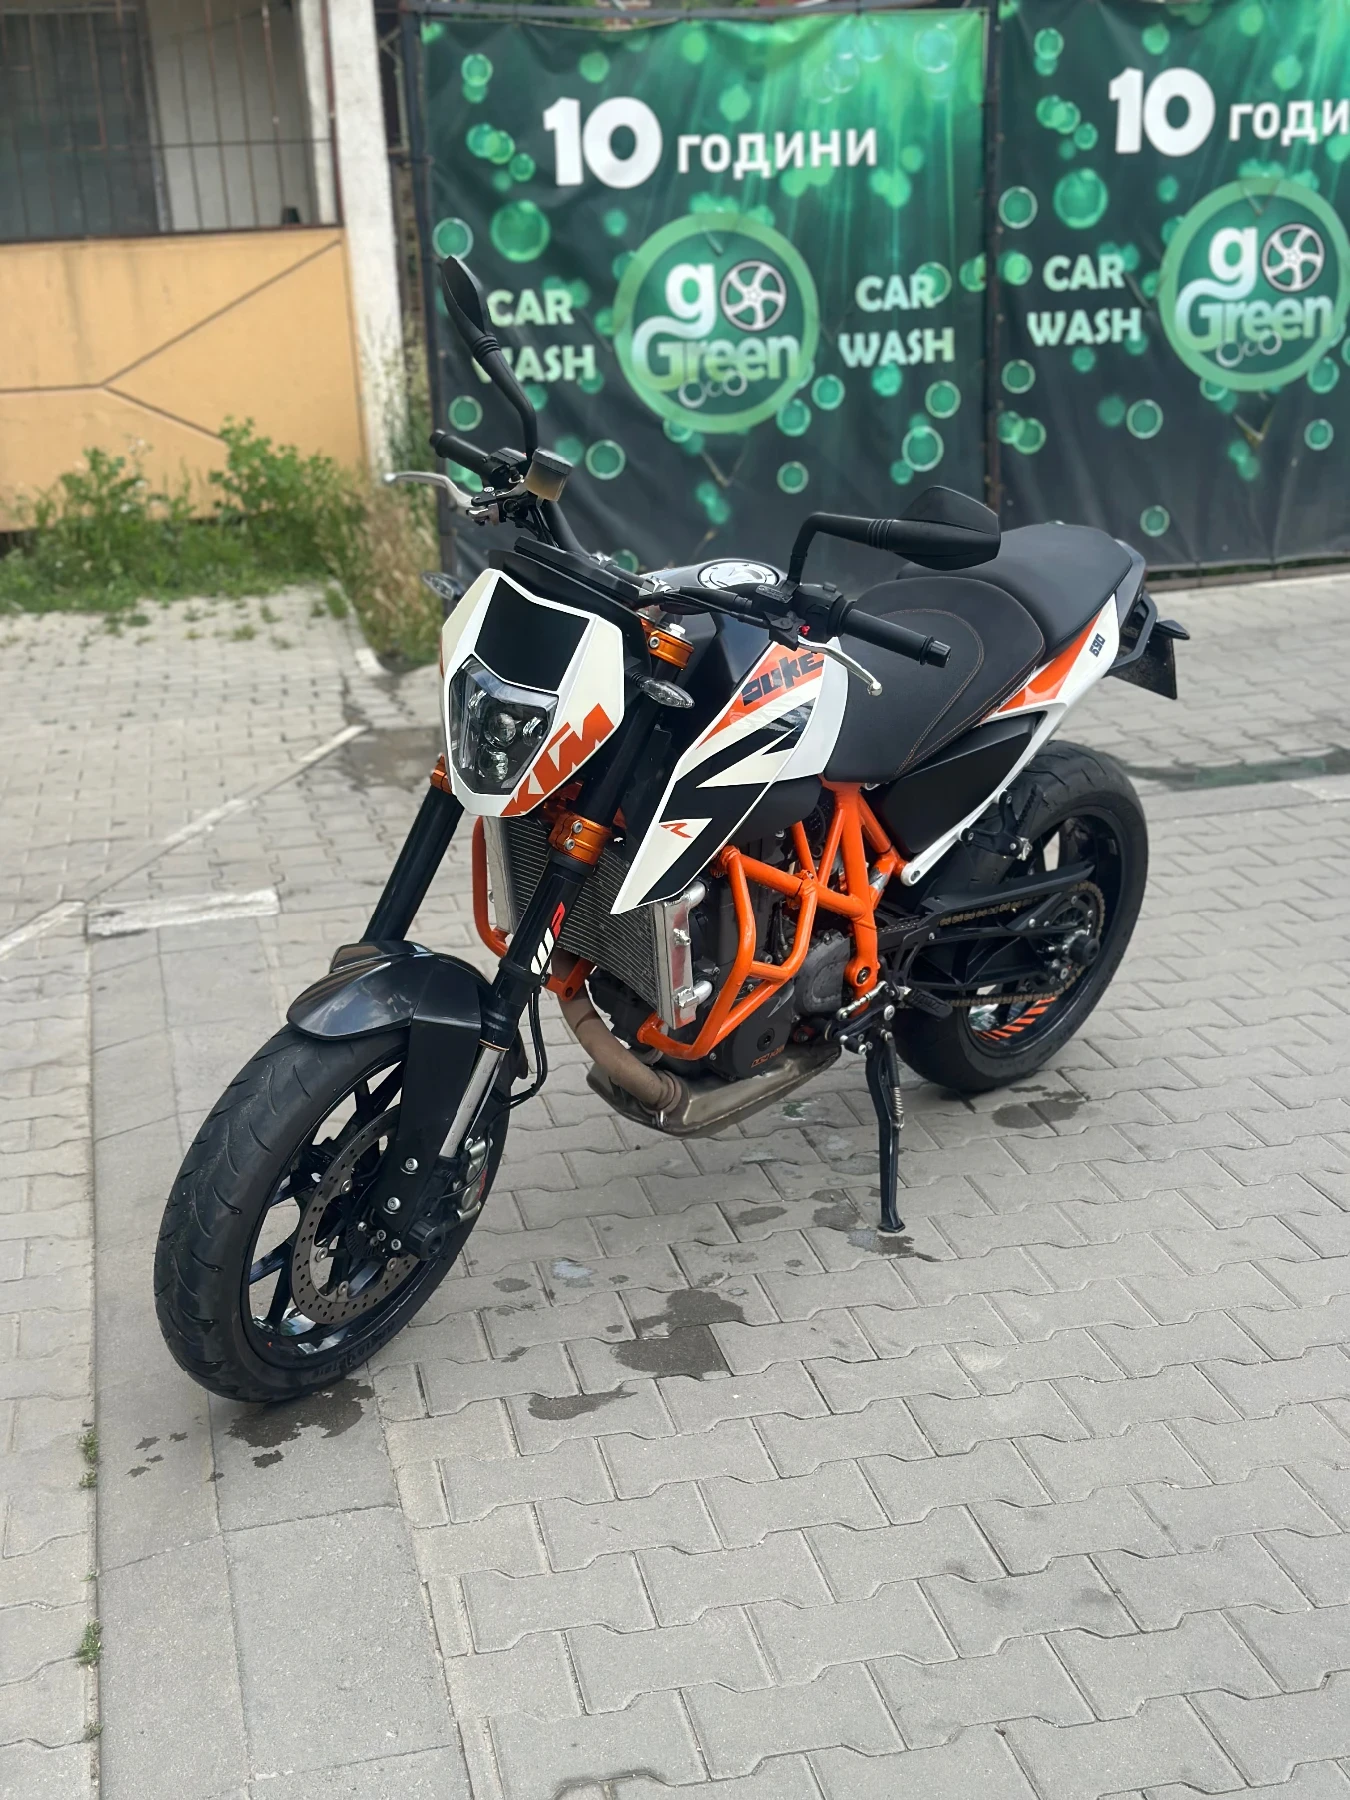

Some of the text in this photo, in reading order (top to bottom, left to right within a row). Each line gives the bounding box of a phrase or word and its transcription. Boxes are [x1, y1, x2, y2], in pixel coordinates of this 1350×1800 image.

[1109, 67, 1216, 157] 10
[543, 96, 662, 188] 10
[855, 274, 937, 313] CAR
[1043, 254, 1125, 292] CAR
[486, 289, 575, 328] CAR
[1026, 307, 1142, 348] WASH
[1175, 278, 1334, 352] Green
[631, 315, 801, 393] Green
[838, 326, 955, 368] WASH
[1089, 633, 1106, 658] 690
[500, 702, 615, 816] KTM
